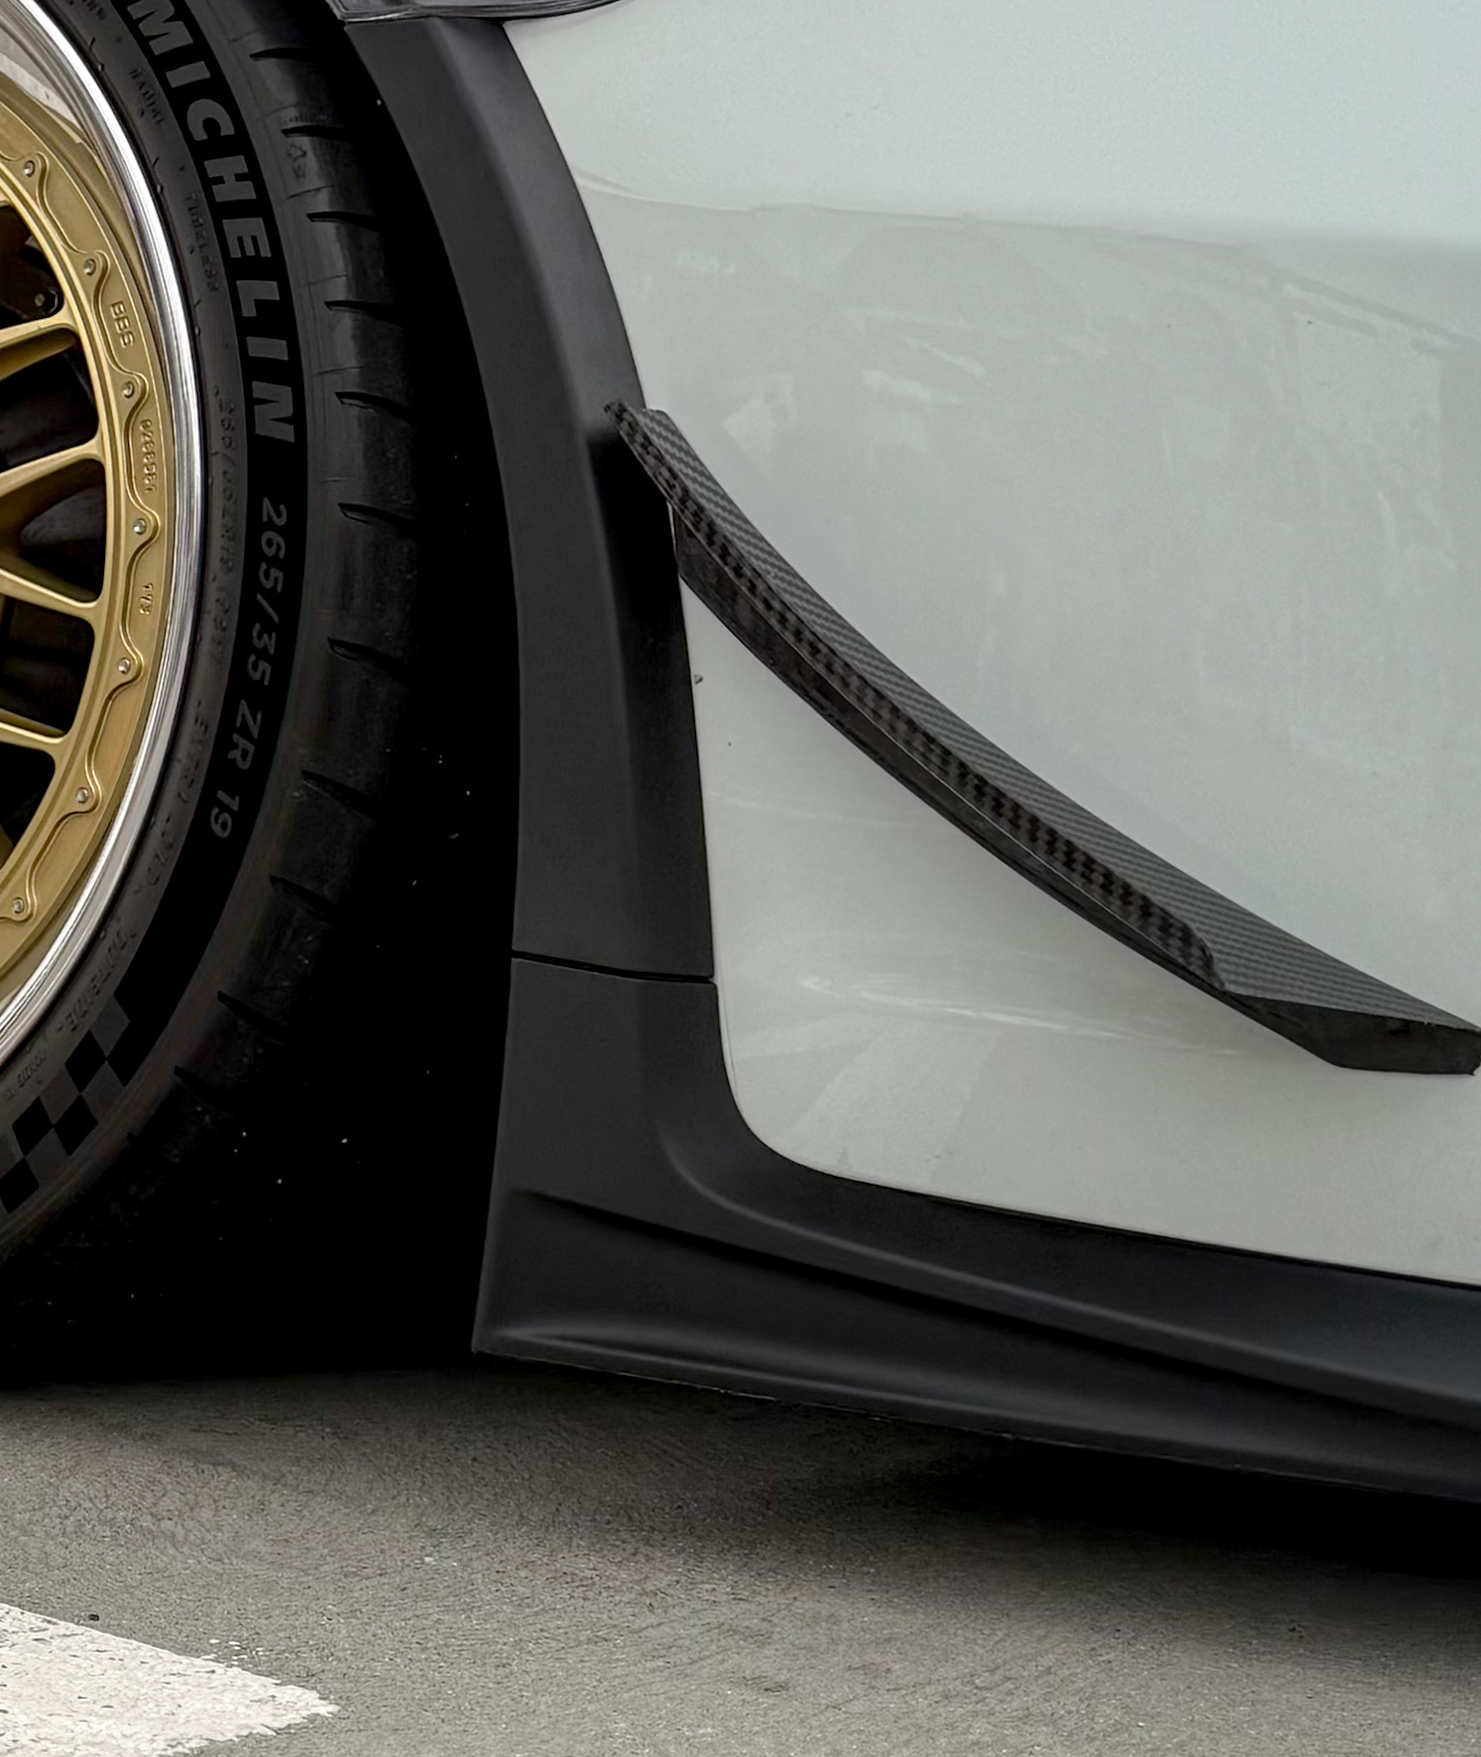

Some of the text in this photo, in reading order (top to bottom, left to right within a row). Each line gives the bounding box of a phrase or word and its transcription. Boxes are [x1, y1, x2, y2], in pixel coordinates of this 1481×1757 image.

[110, 300, 135, 348] BBS
[209, 496, 287, 838] 265/35 ZR 19
